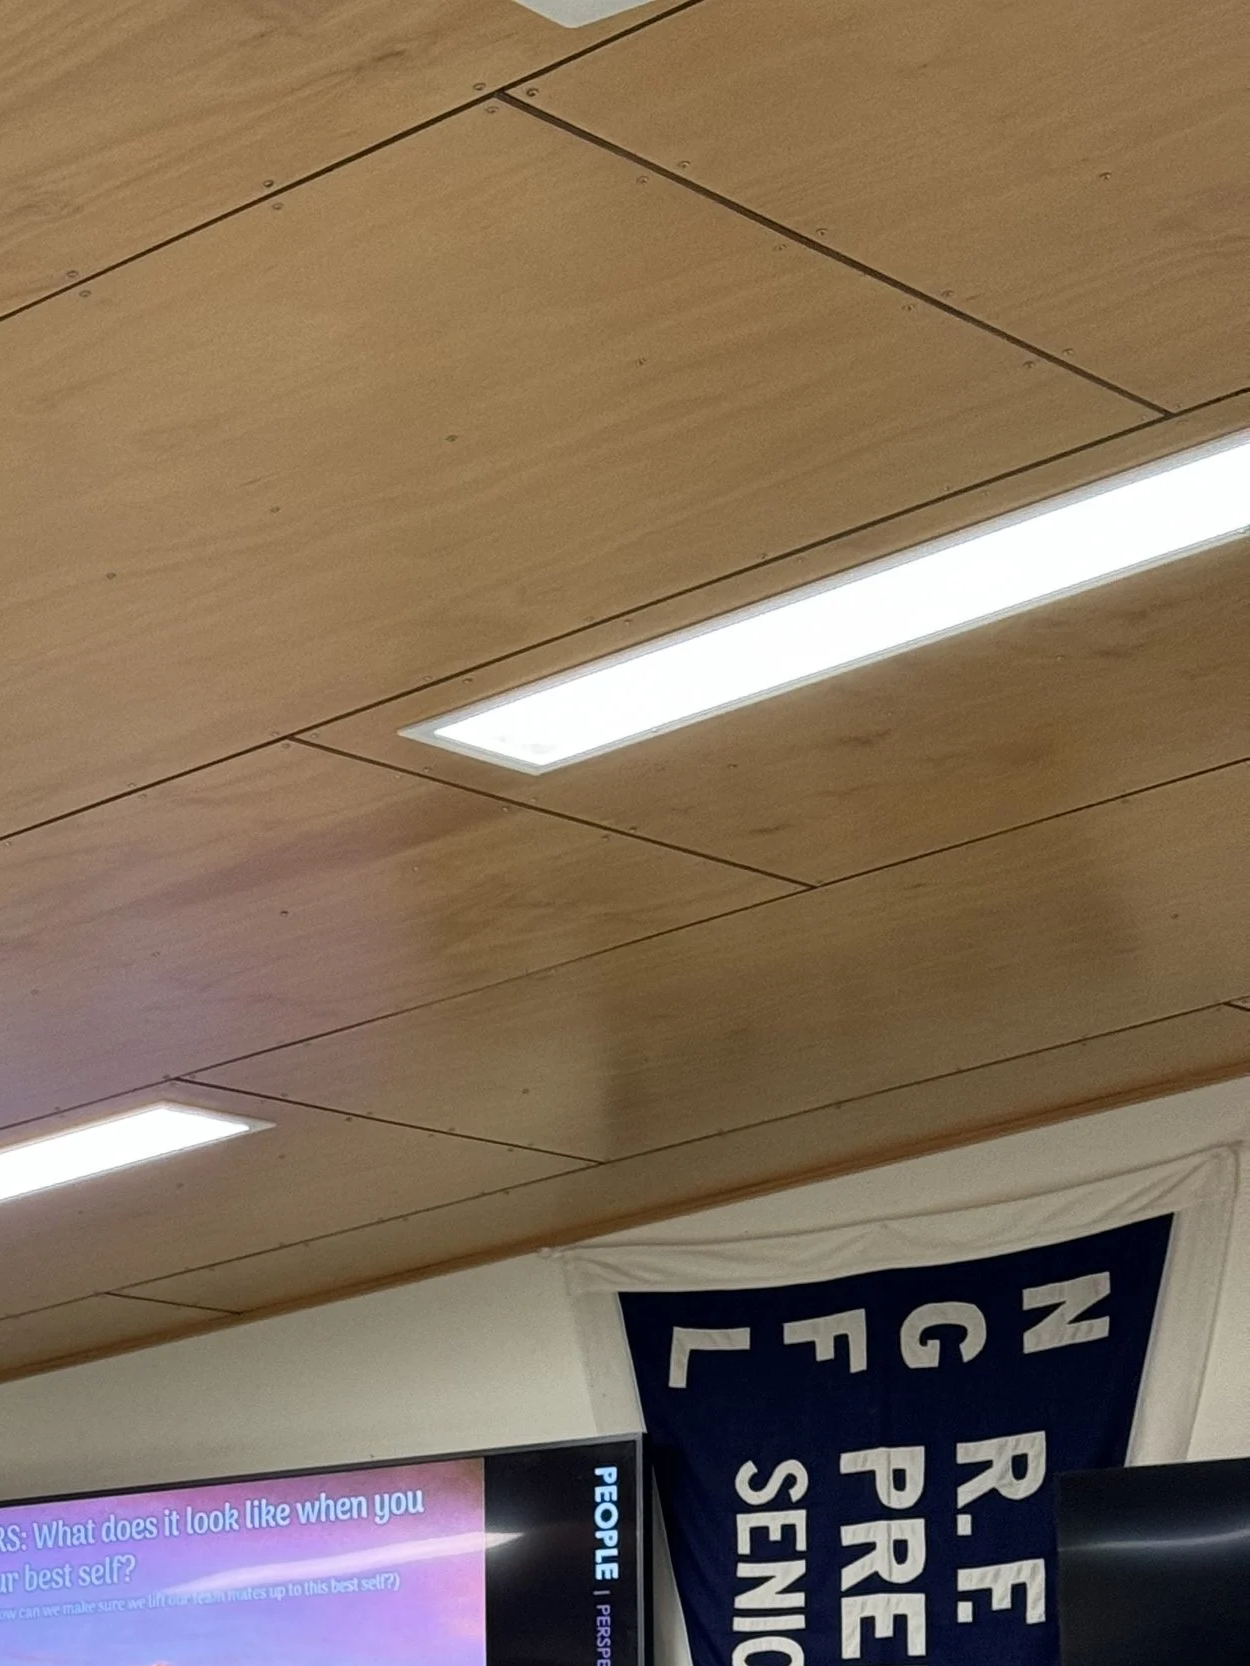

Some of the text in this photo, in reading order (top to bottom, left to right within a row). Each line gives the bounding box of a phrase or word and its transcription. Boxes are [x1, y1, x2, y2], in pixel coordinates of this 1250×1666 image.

[33, 1520, 95, 1549] What
[102, 1515, 157, 1542] does
[164, 1509, 179, 1536] it
[187, 1502, 239, 1534] look
[245, 1498, 290, 1529] like
[296, 1493, 367, 1524] when
[374, 1490, 424, 1524] you
[594, 1467, 619, 1580] PEOPLE
[19, 1607, 40, 1620] can
[42, 1605, 60, 1617] we
[63, 1600, 95, 1616] make
[98, 1599, 125, 1613] sure
[128, 1597, 146, 1610] we
[149, 1593, 165, 1608] lift
[269, 1585, 286, 1601] up
[288, 1582, 301, 1597] to
[304, 1579, 328, 1595] this
[330, 1577, 359, 1593] best
[24, 1564, 72, 1592] best
[78, 1554, 135, 1586] self?
